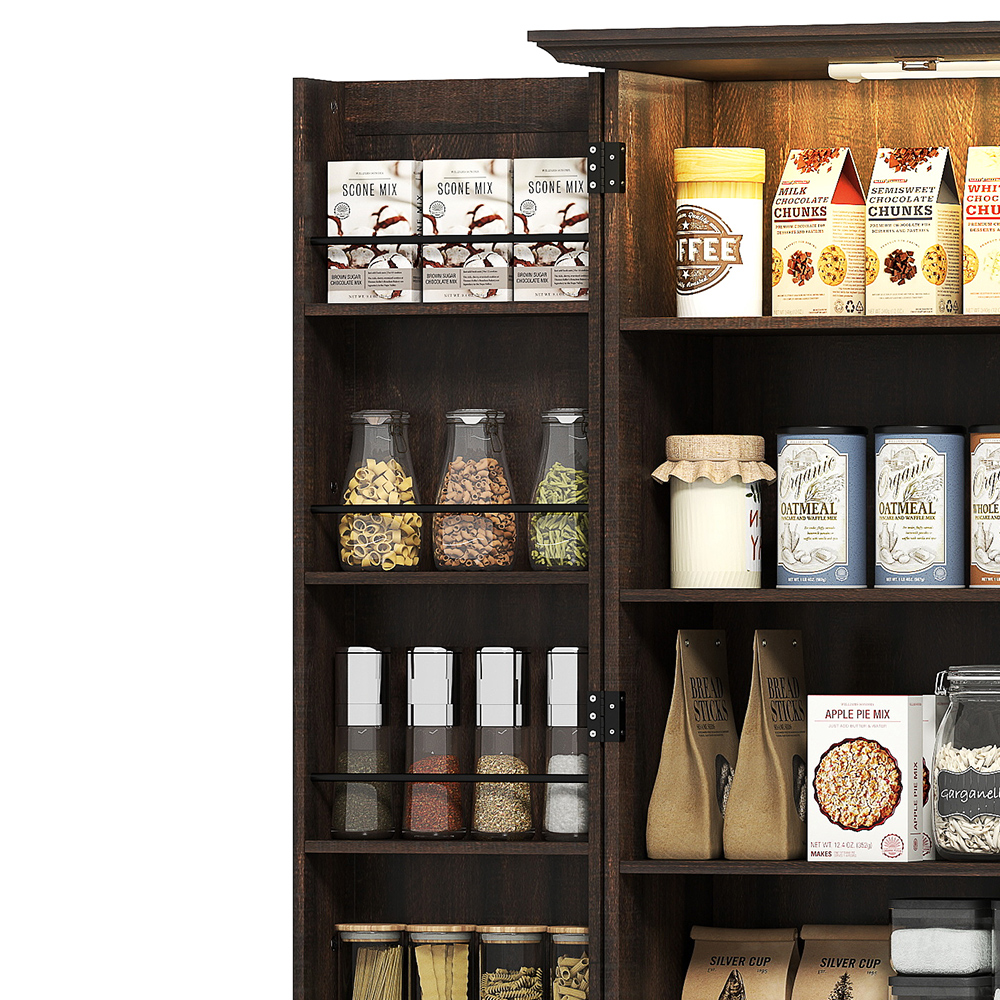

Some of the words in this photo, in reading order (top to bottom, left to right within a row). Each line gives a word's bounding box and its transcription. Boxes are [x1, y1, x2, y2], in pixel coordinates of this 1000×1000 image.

[342, 183, 375, 197] SCONE
[379, 183, 398, 197] MIX
[437, 182, 470, 196] SCONE
[474, 181, 493, 195] MIX
[528, 180, 561, 194] SCONE
[565, 180, 585, 194] MIX
[778, 186, 807, 196] MILK
[871, 186, 936, 194] SEMISWEET
[775, 196, 829, 205] CHOCOLATE
[869, 195, 934, 204] CHOCOLATE
[774, 206, 827, 218] CHUNKS
[868, 205, 933, 217] CHUNKS
[676, 237, 737, 263] FFEE
[780, 455, 836, 500] Organic
[878, 455, 935, 500] Organic
[780, 502, 838, 516] OATMEAL
[878, 502, 936, 515] OATMEAL
[973, 504, 999, 514] WHOLE
[690, 677, 724, 699] BREAD
[766, 677, 800, 699] BREAD
[693, 700, 729, 722] STICKS
[770, 700, 805, 722] STICKS
[825, 709, 854, 719] APPLE
[856, 709, 871, 719] PIE
[873, 709, 890, 719] MIX
[709, 956, 746, 966] SILVER
[748, 956, 771, 967] CUP
[820, 957, 856, 968] SILVER
[858, 958, 882, 969] CUP
